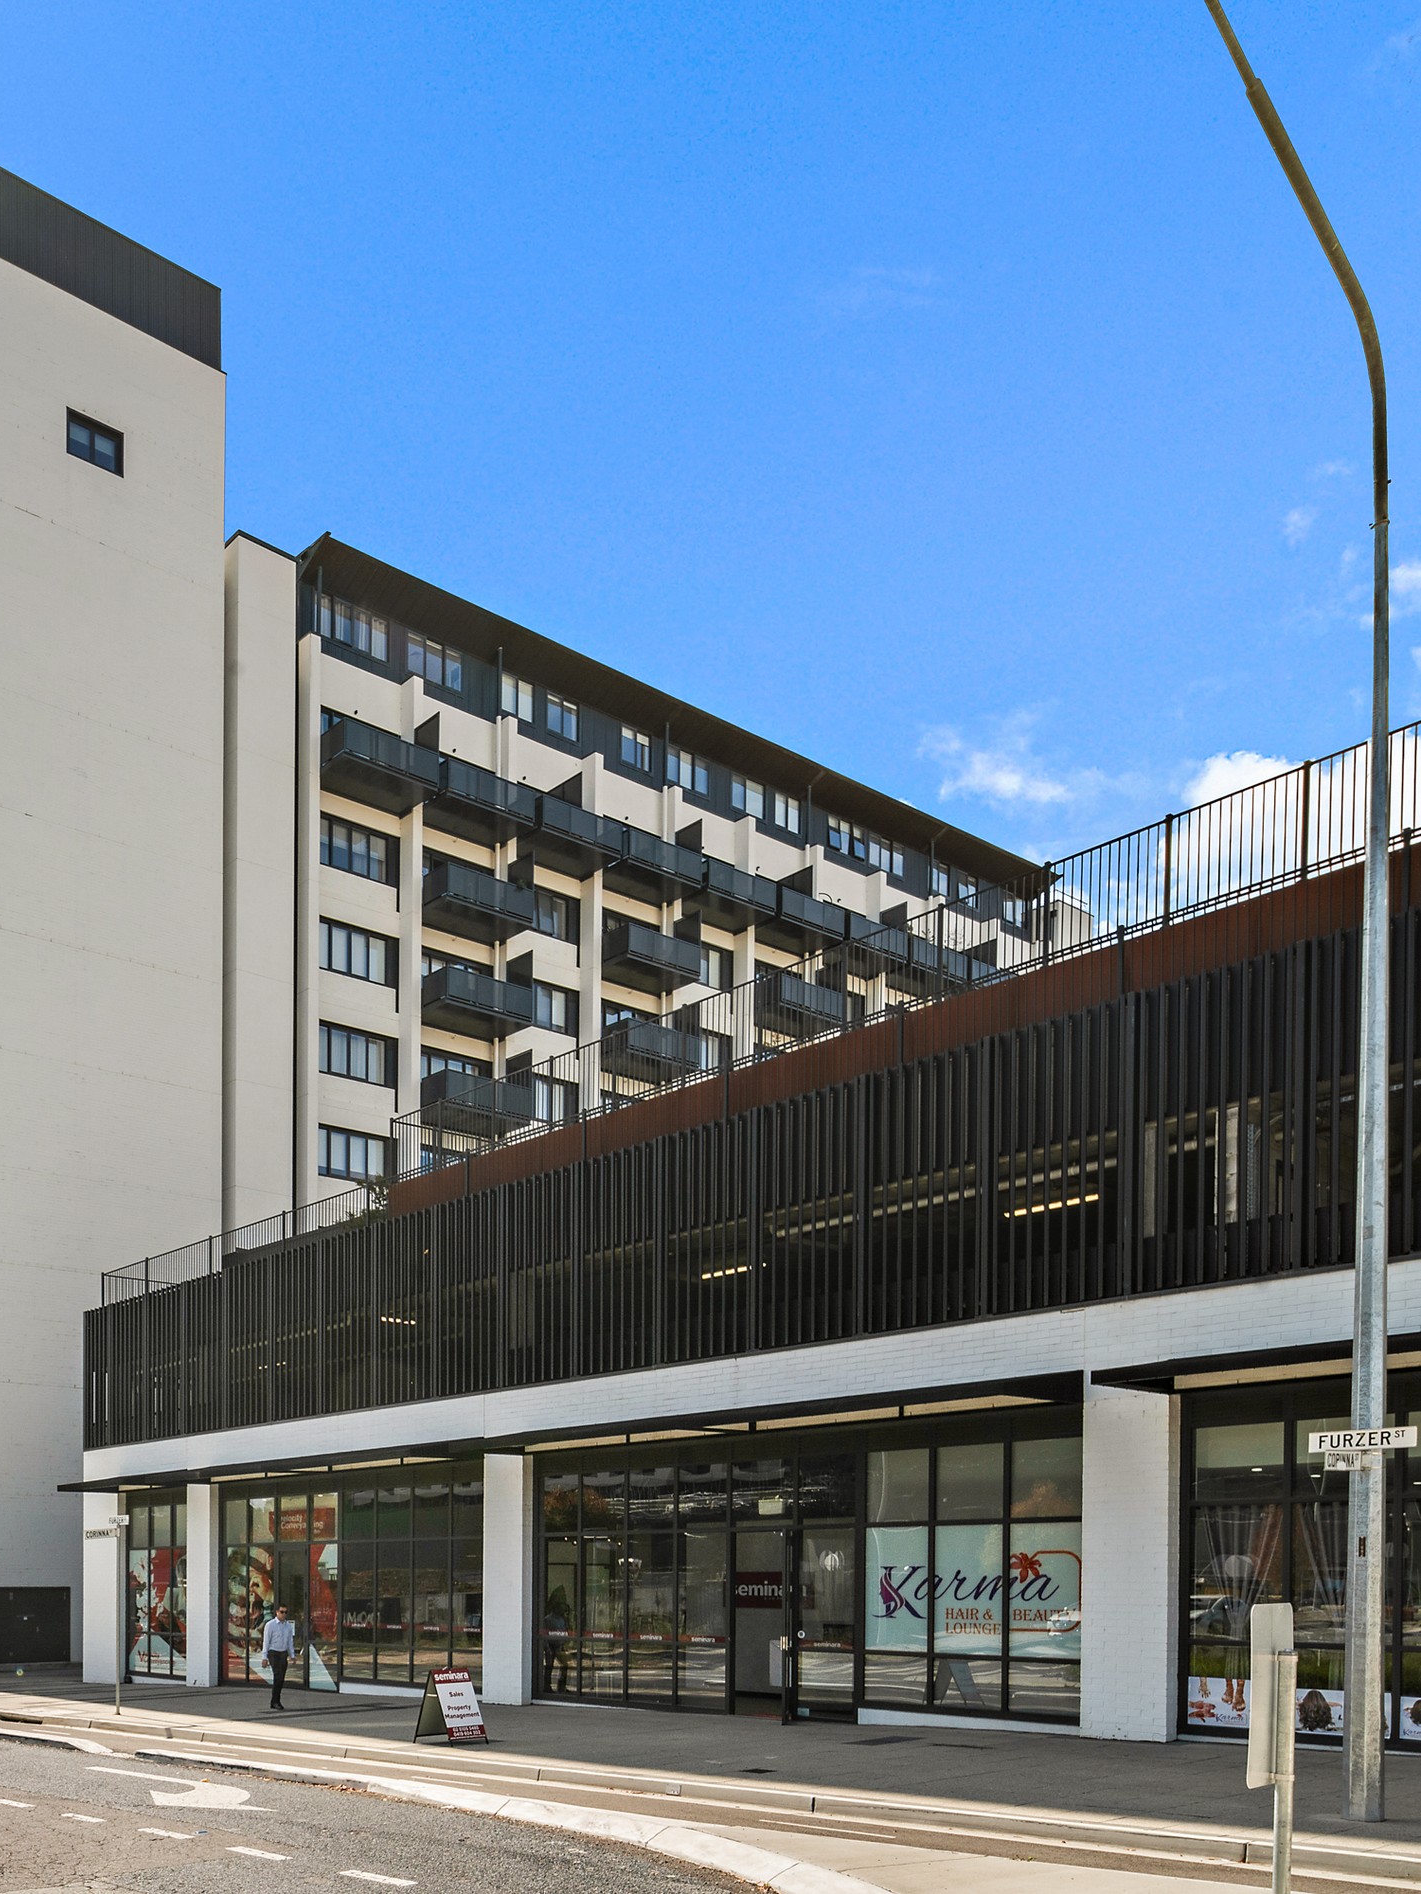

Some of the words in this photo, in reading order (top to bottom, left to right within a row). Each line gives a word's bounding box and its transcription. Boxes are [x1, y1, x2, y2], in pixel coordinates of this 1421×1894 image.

[1319, 1431, 1391, 1449] FURZER
[1394, 1430, 1406, 1438] ST
[86, 1530, 109, 1539] CORINNA
[872, 1565, 1060, 1620] Karma
[945, 1608, 979, 1621] HAIR
[983, 1608, 994, 1621] &
[945, 1622, 1001, 1635] LOUNGE
[434, 1671, 469, 1681] seminara
